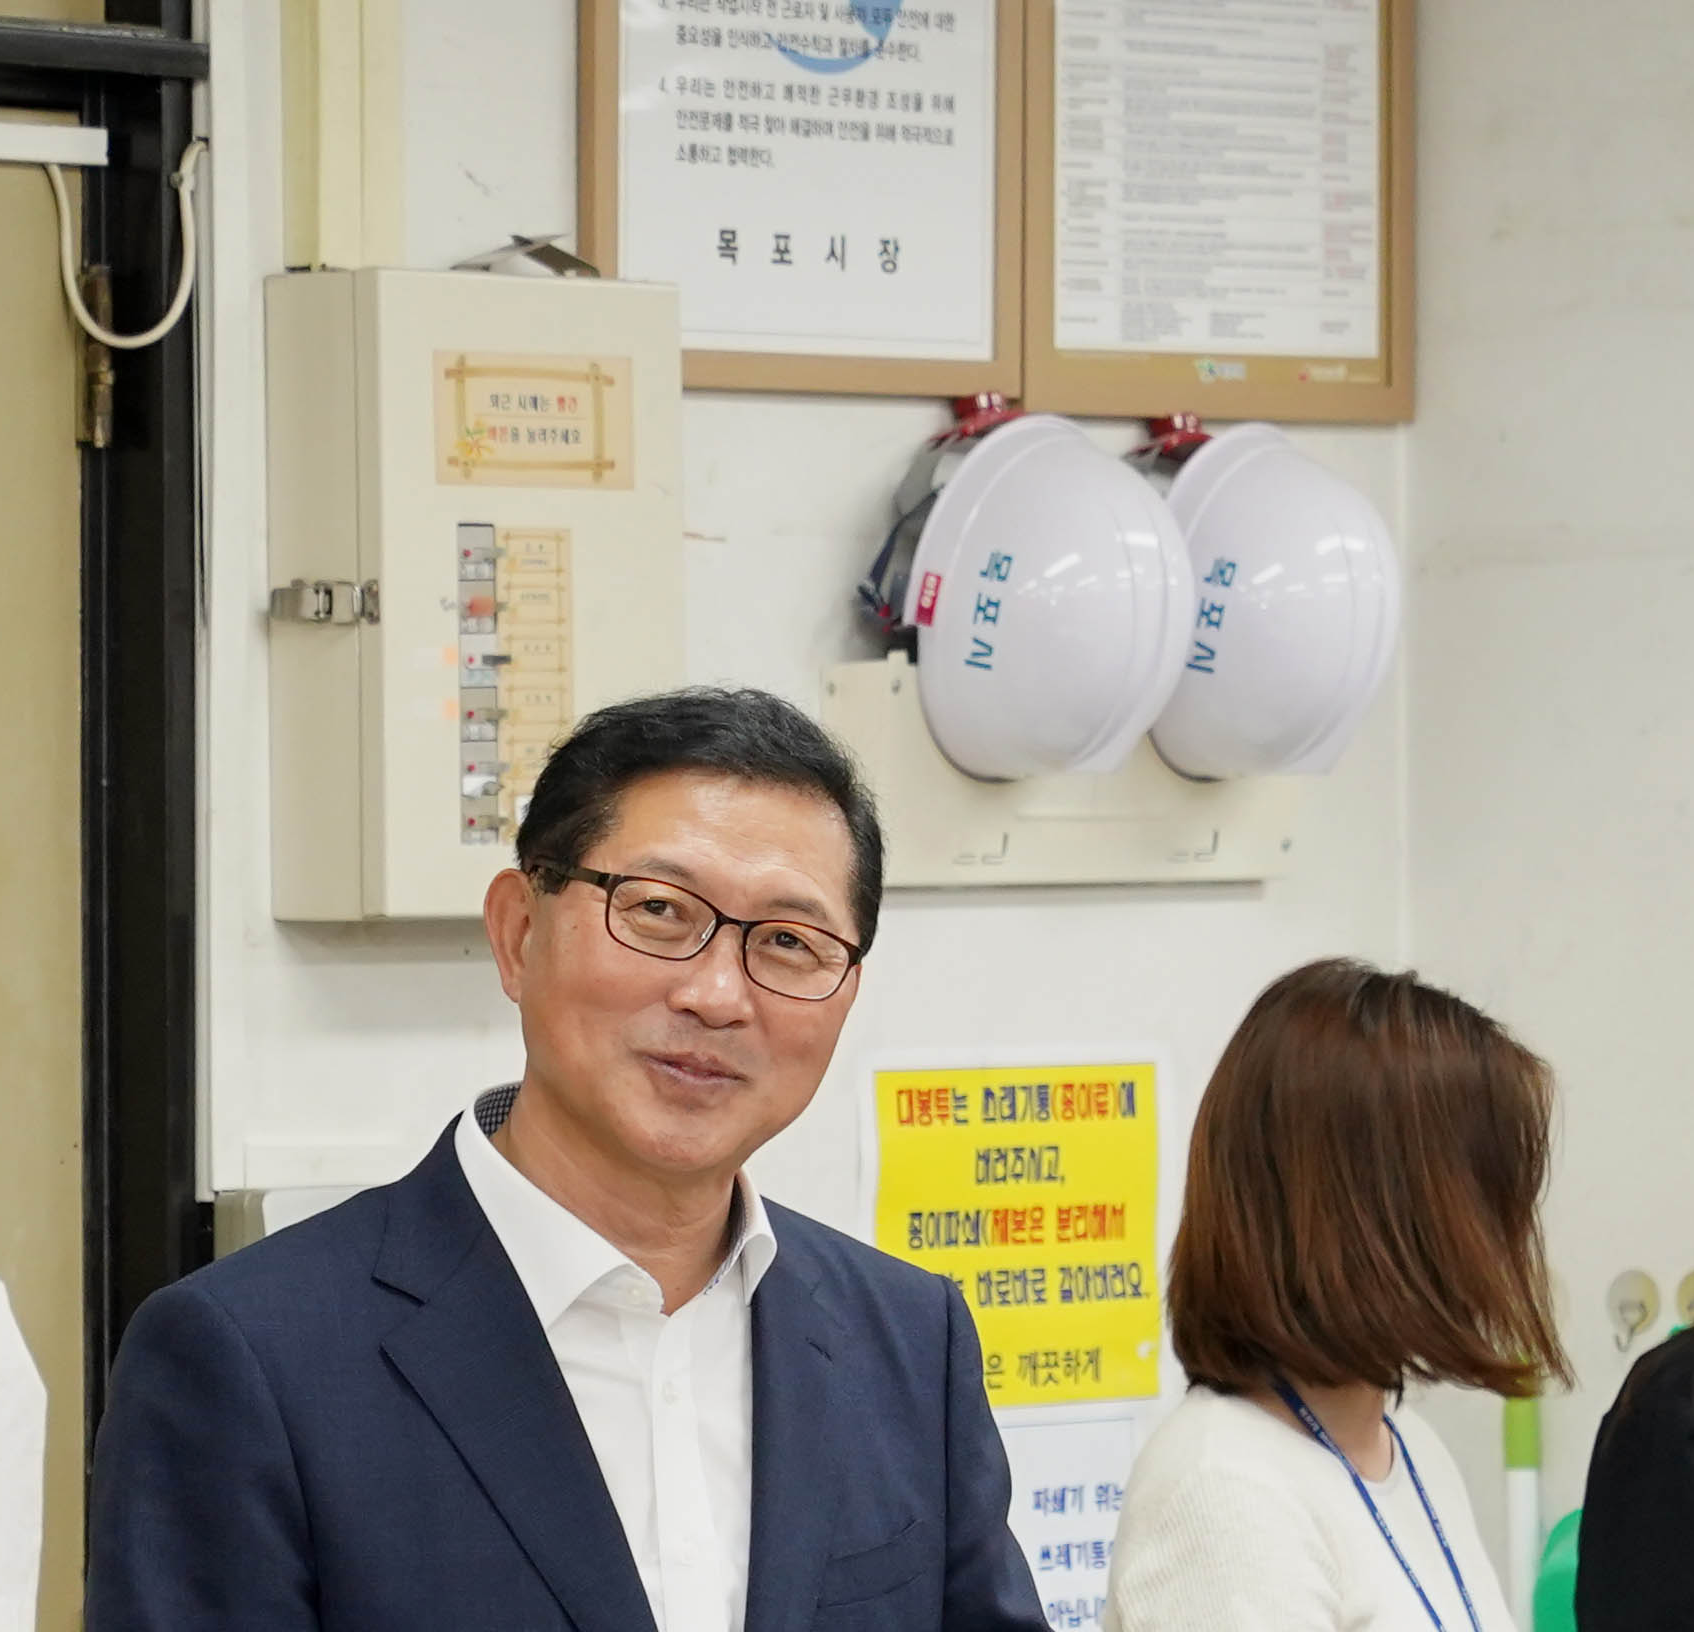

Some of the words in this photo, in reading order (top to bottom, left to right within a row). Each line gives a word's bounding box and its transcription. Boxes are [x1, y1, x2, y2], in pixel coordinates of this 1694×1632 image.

[896, 1087, 969, 1126] 대봉투는
[1039, 1541, 1114, 1570] 쓰레기통
[1047, 1597, 1106, 1628] 아닙니
